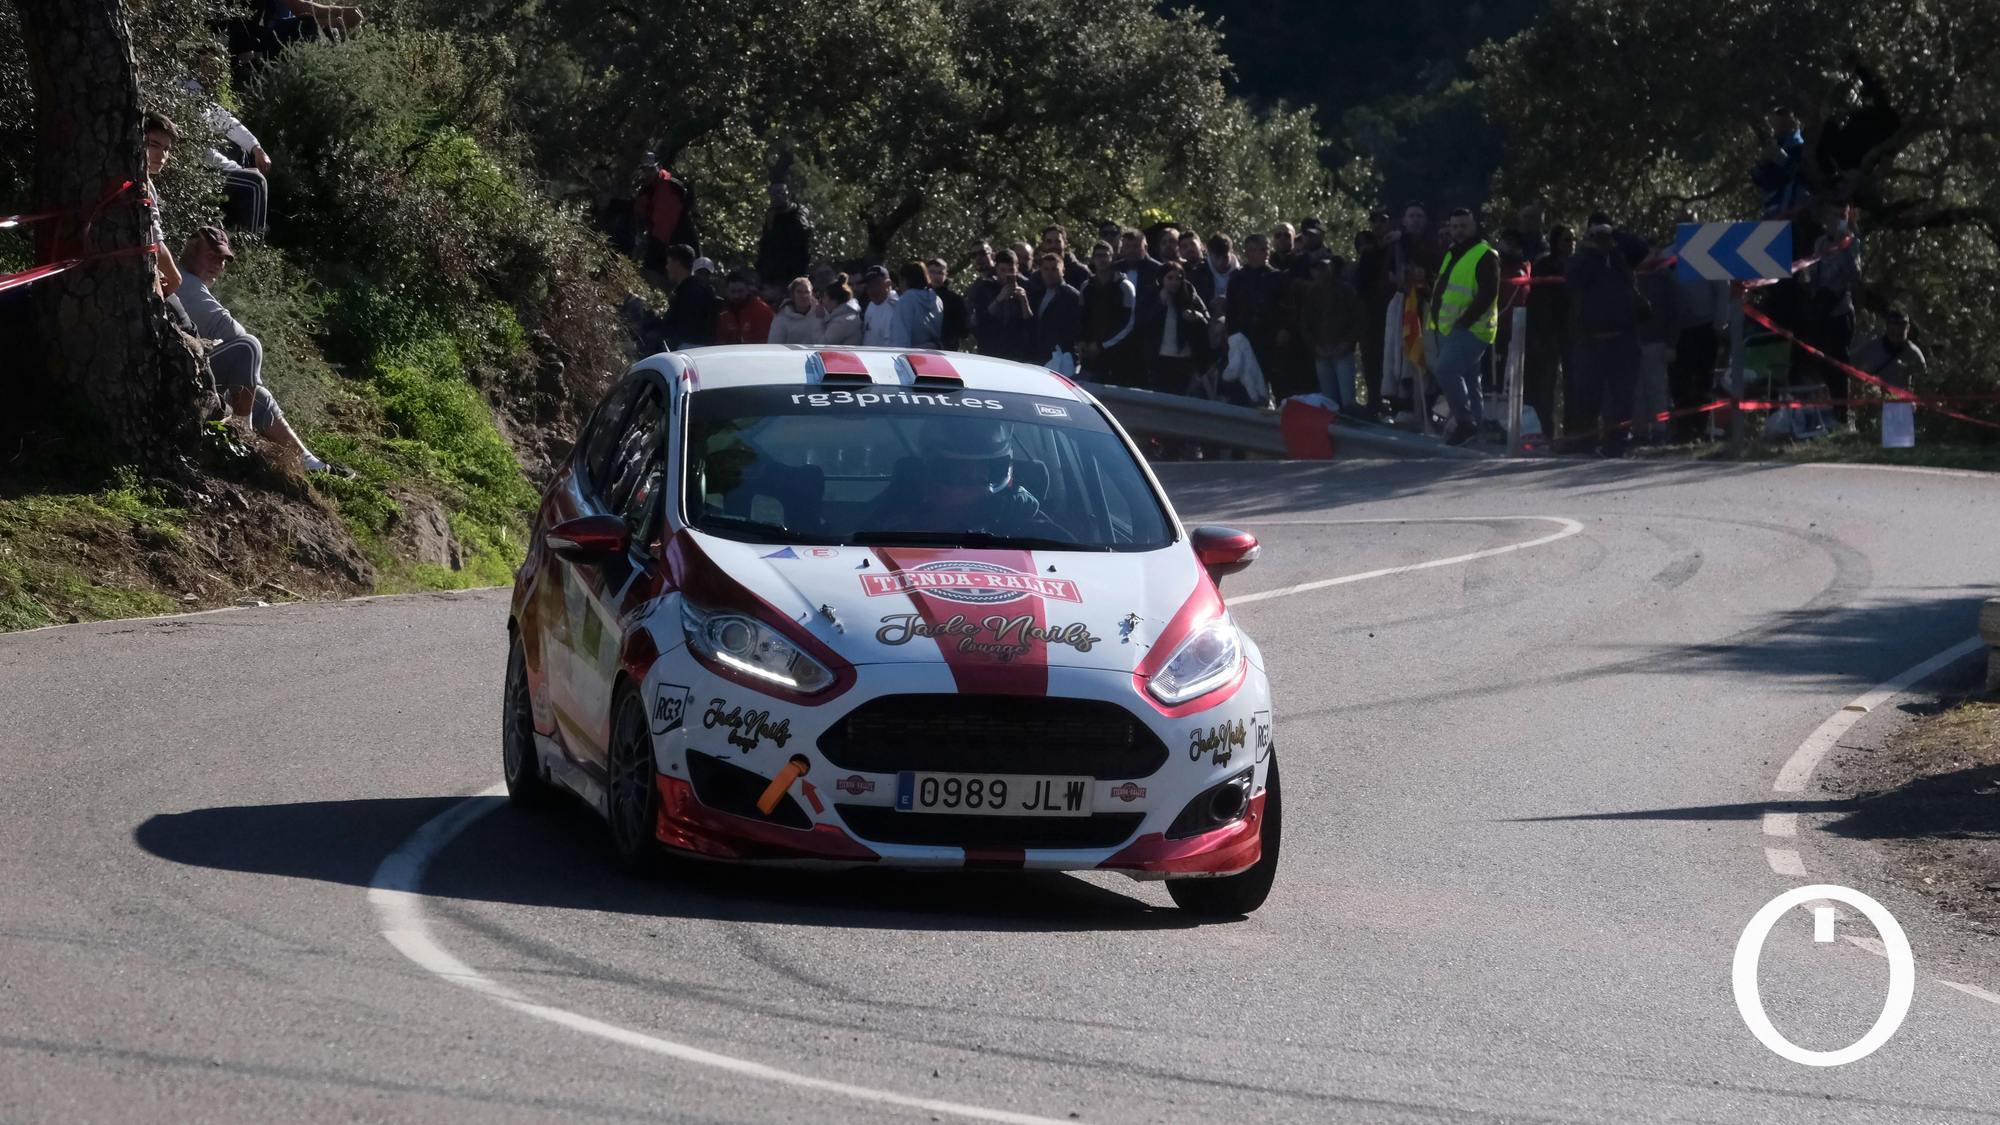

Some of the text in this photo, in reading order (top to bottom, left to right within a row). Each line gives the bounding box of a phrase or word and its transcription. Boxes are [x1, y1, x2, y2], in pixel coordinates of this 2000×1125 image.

[791, 390, 1004, 410] rg3print.es
[875, 613, 1102, 653] Jade Nails
[956, 637, 1033, 662] lounge
[655, 696, 682, 722] RG3
[901, 795, 909, 804] E
[920, 776, 1086, 811] 0989 JLW
